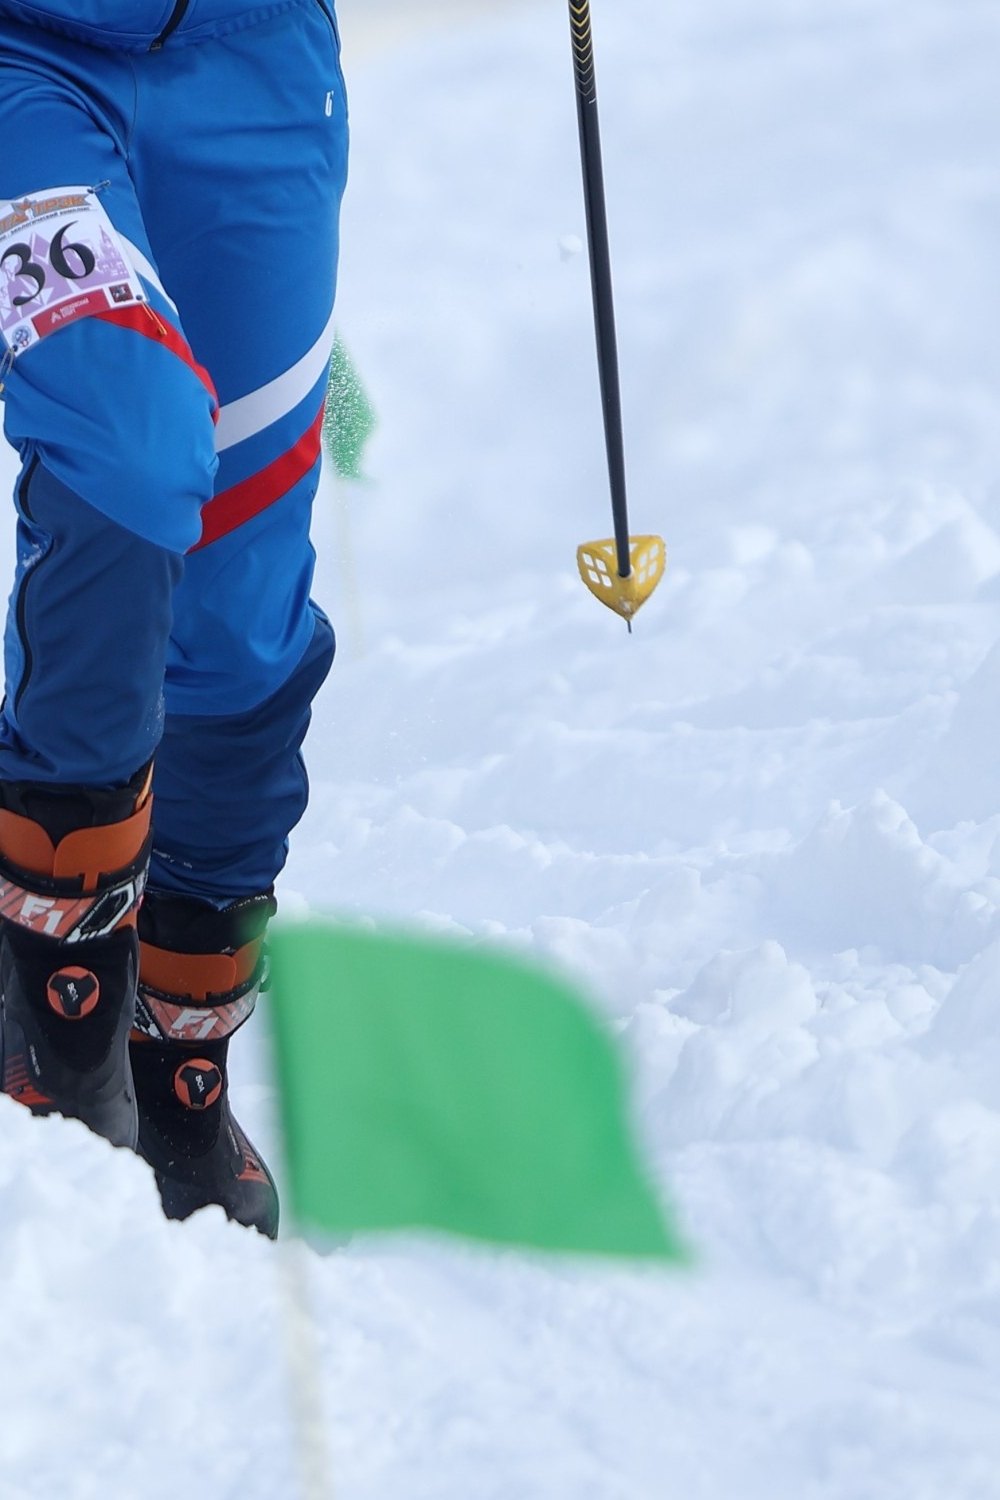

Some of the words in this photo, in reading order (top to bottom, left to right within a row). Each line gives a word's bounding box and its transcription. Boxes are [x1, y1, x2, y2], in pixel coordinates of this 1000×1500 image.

[0, 219, 96, 307] 36
[20, 894, 64, 935] F1
[170, 1008, 220, 1040] F1
[195, 1074, 206, 1093] BOA
